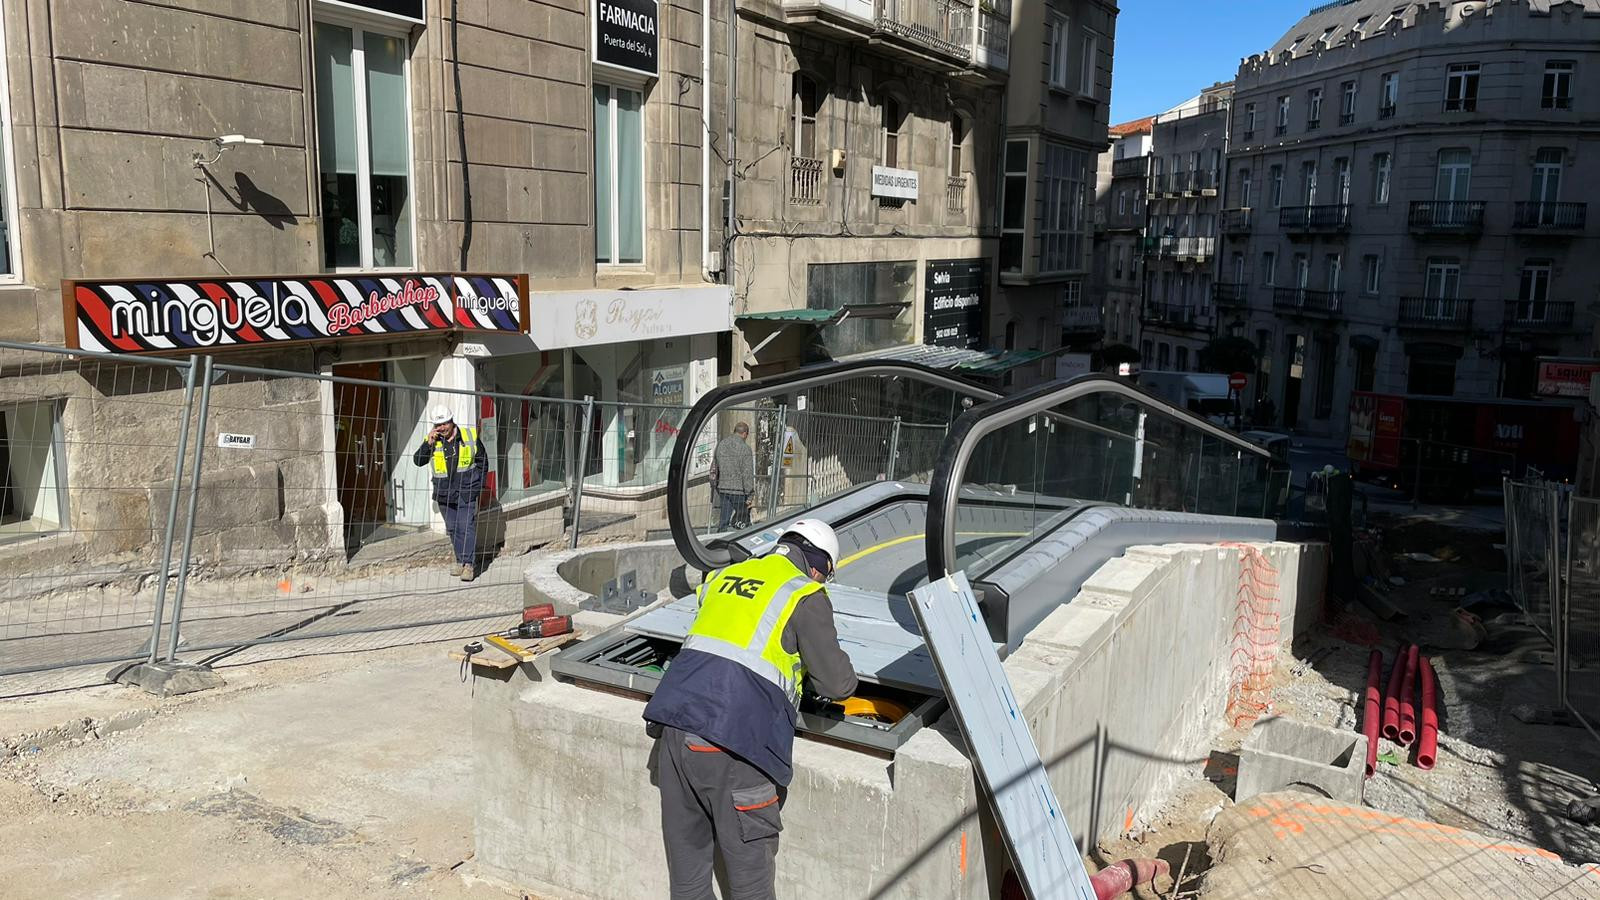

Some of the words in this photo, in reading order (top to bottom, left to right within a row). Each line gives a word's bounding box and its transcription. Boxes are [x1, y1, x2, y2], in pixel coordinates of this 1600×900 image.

[600, 2, 655, 35] FARMACIA
[604, 33, 626, 49] Puerta
[626, 41, 636, 51] del
[636, 42, 648, 56] Sol,
[894, 177, 917, 189] URGENTES
[112, 282, 307, 346] minguela
[327, 279, 439, 334] Barbershop
[456, 291, 519, 315] minguela
[933, 295, 953, 310] Edificio
[718, 576, 765, 599] TKE
